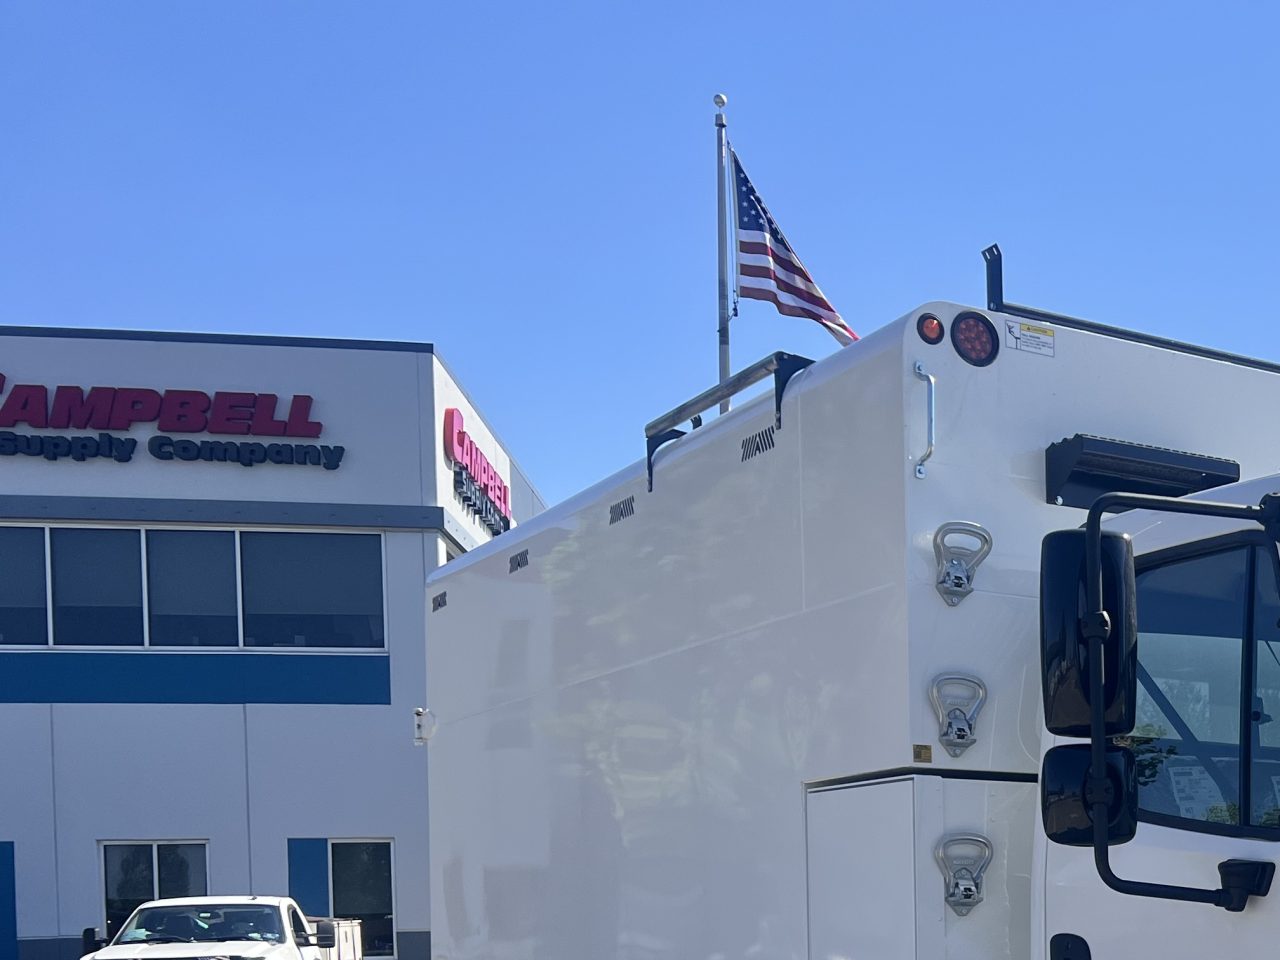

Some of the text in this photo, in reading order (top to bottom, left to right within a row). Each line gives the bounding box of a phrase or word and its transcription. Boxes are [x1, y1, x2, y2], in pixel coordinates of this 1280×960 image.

[0, 373, 323, 439] AMPBELL
[0, 431, 345, 471] Supply Company
[443, 408, 511, 520] CAMPBELL
